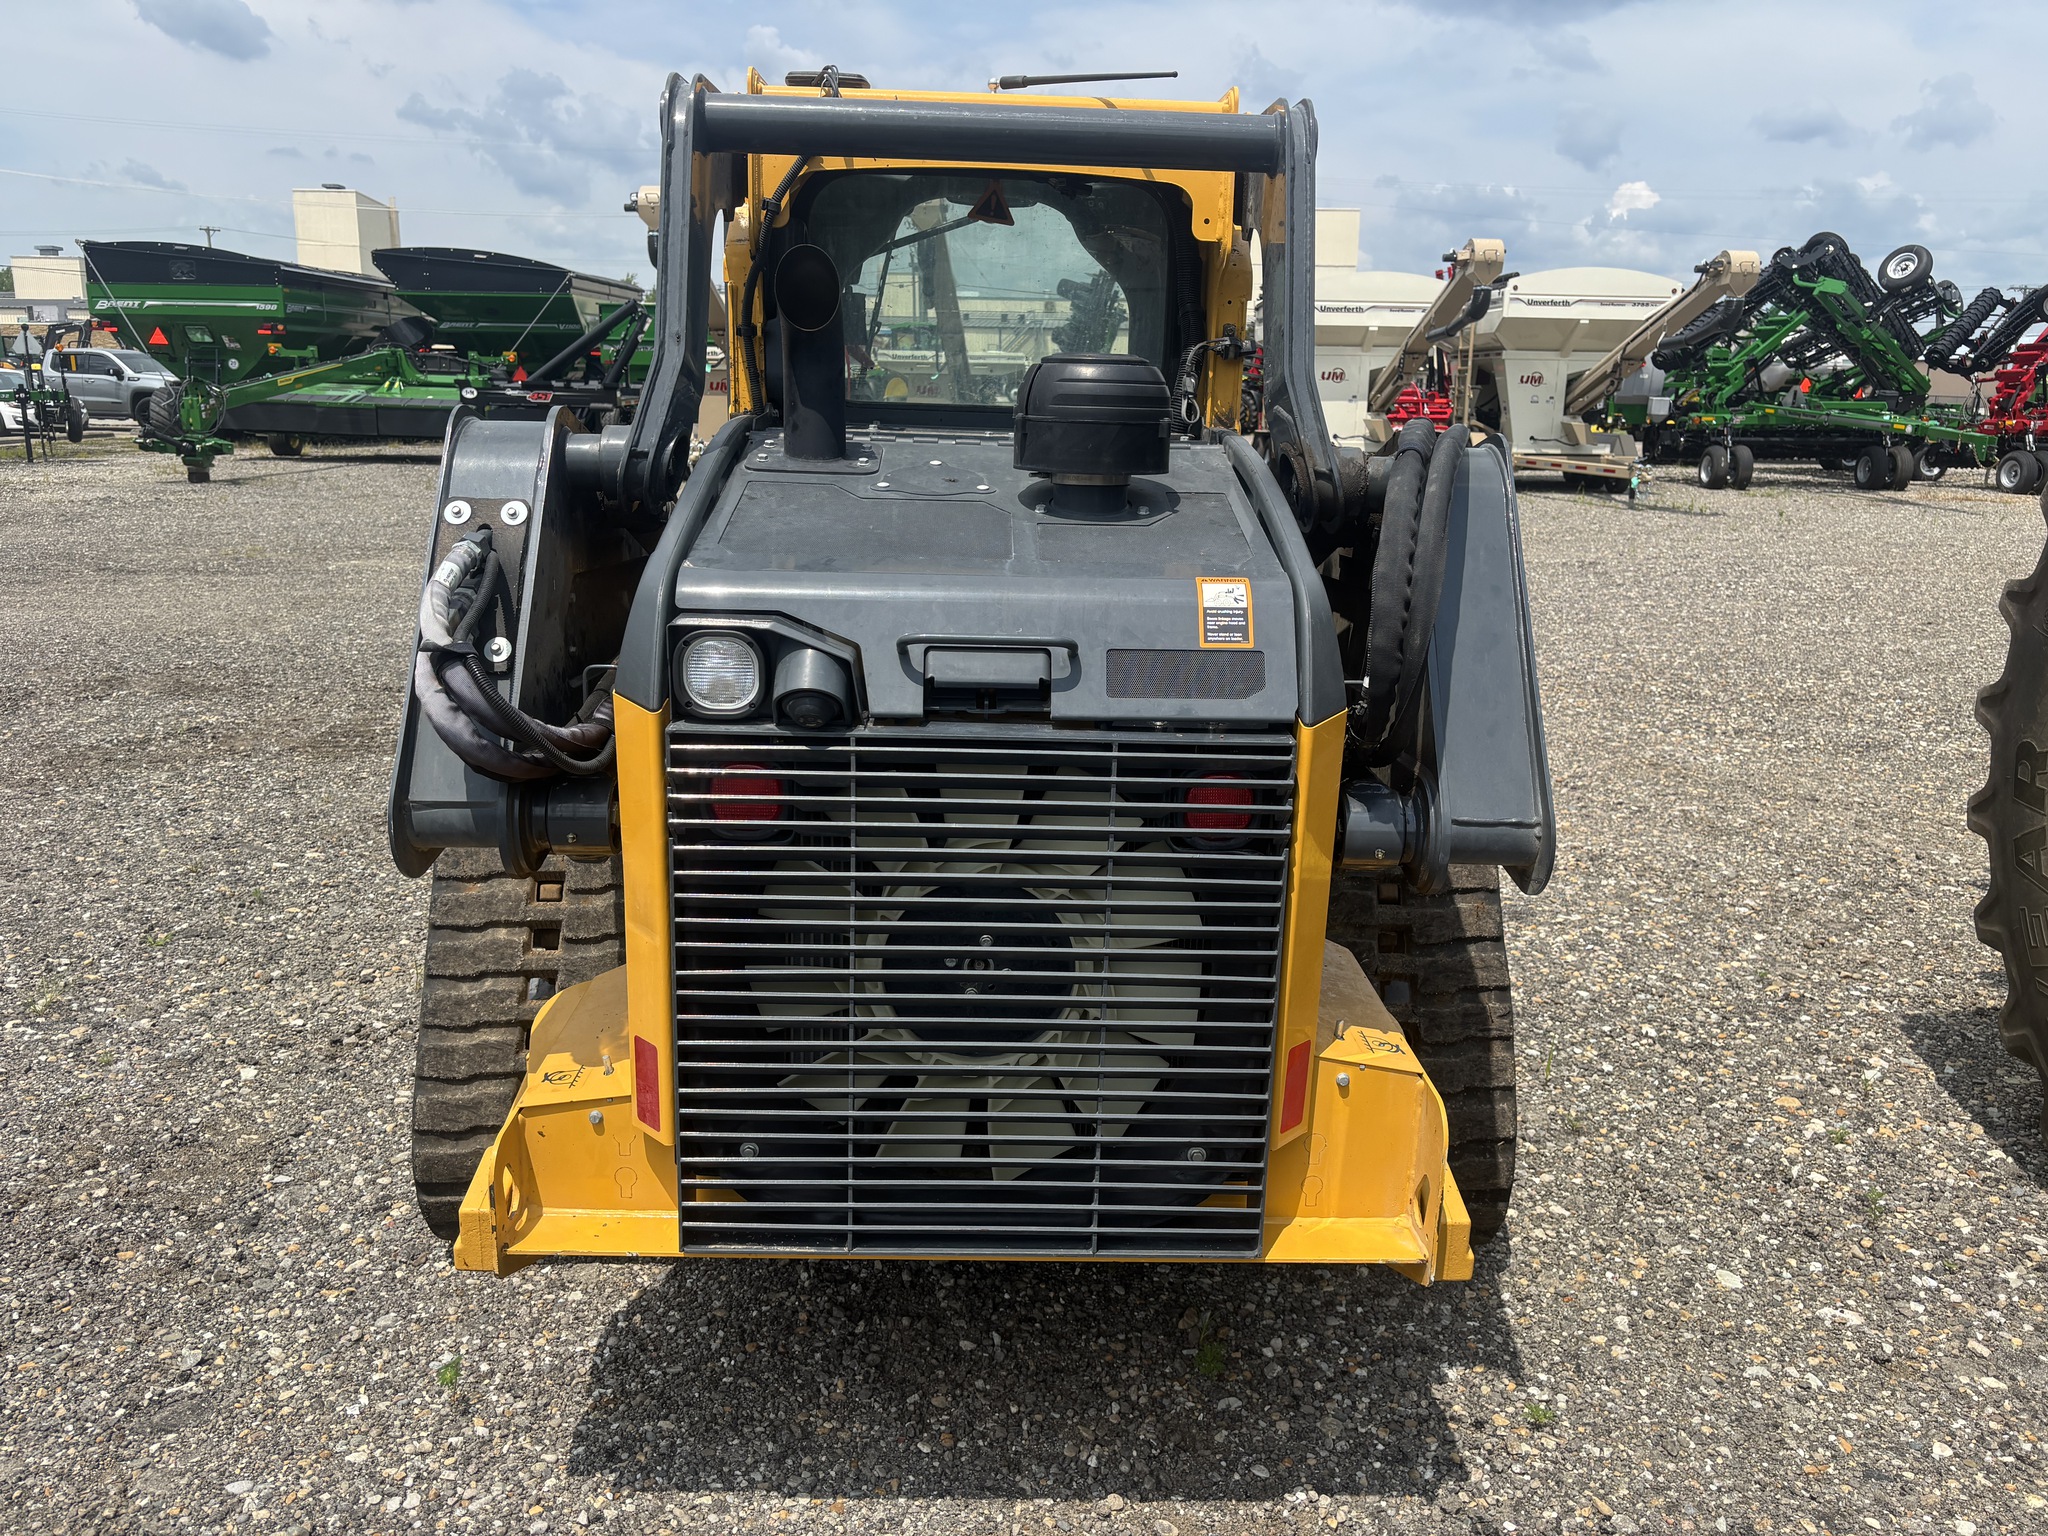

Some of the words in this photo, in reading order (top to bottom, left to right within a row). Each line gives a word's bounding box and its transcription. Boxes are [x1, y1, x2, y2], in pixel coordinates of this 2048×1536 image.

[1527, 298, 1571, 306] Unverferth
[1320, 305, 1364, 313] Unverferth
[2013, 738, 2048, 996] EAR
